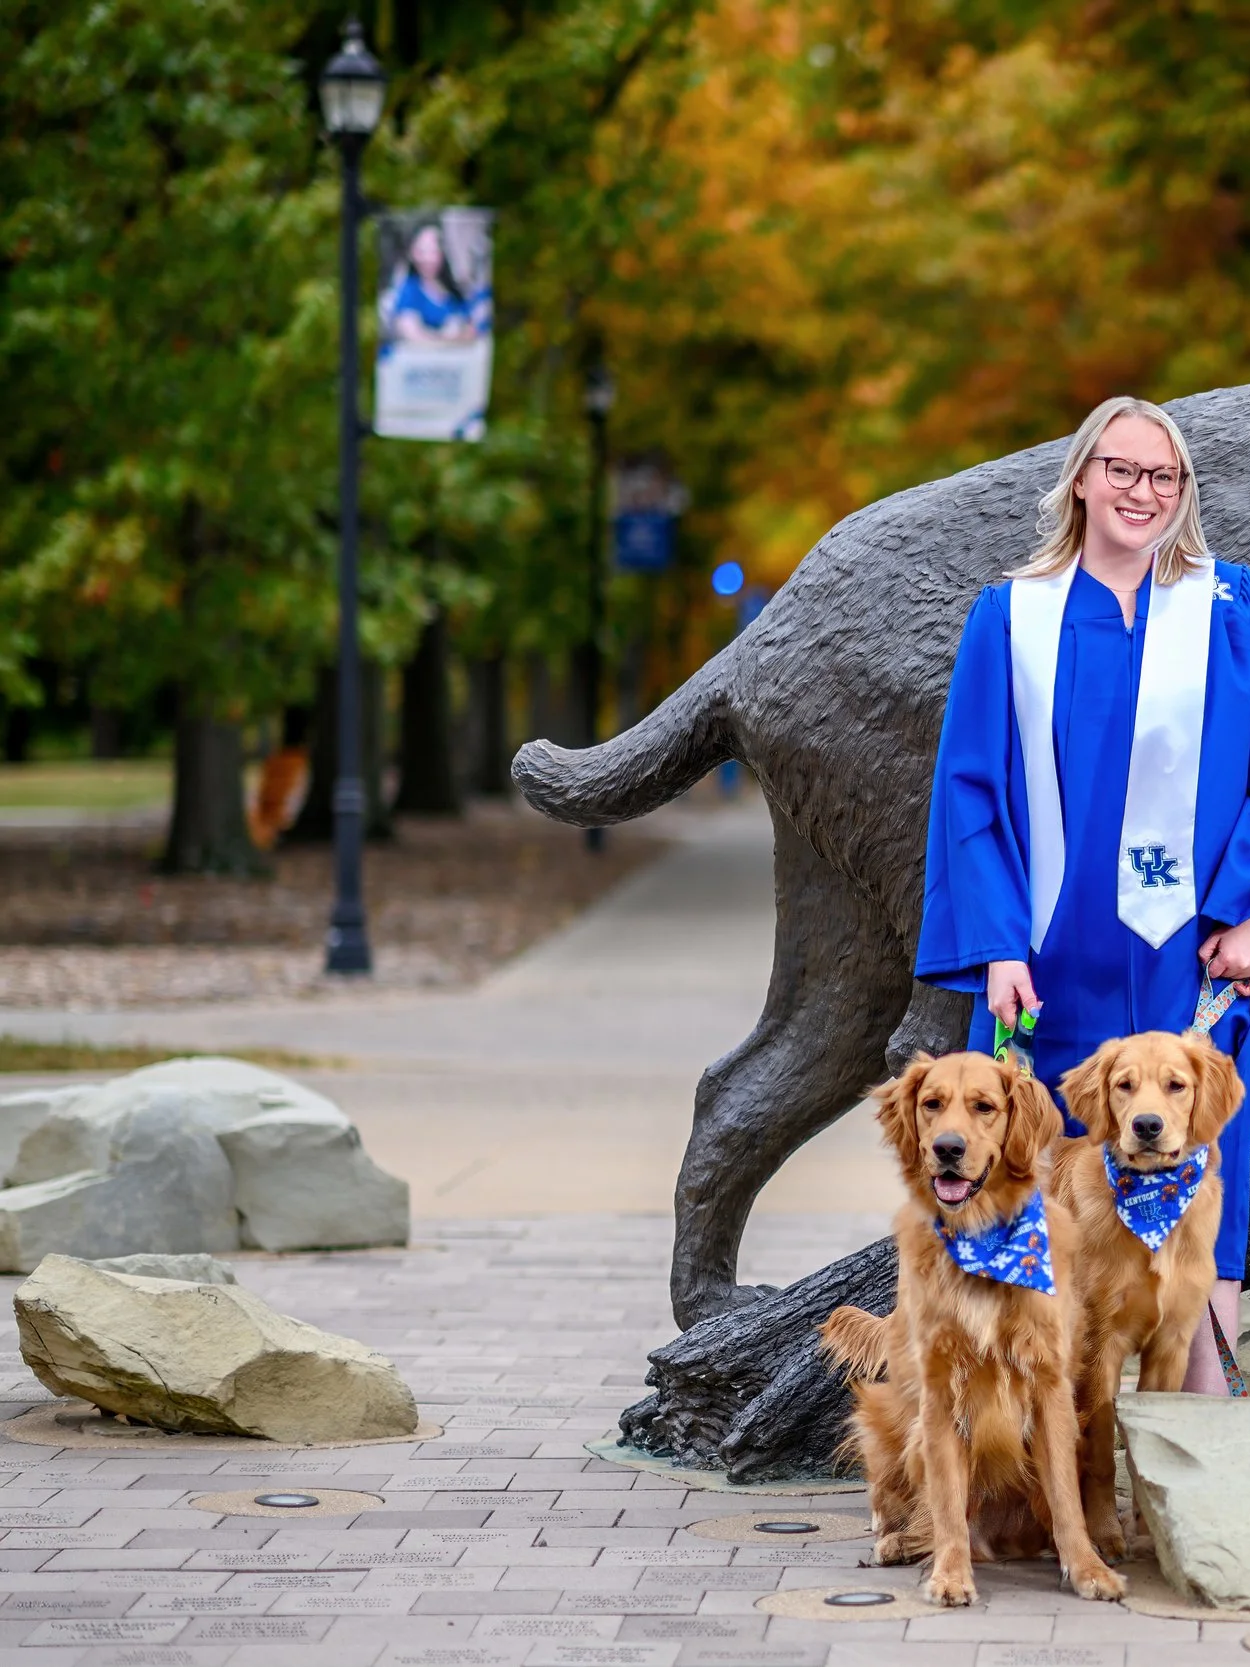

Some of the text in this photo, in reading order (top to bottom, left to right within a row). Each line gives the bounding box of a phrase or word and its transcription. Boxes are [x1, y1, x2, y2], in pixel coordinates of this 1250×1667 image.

[1128, 846, 1180, 888] UK
[1124, 1189, 1160, 1207] KENTUCKY
[1138, 1202, 1162, 1223] UK
